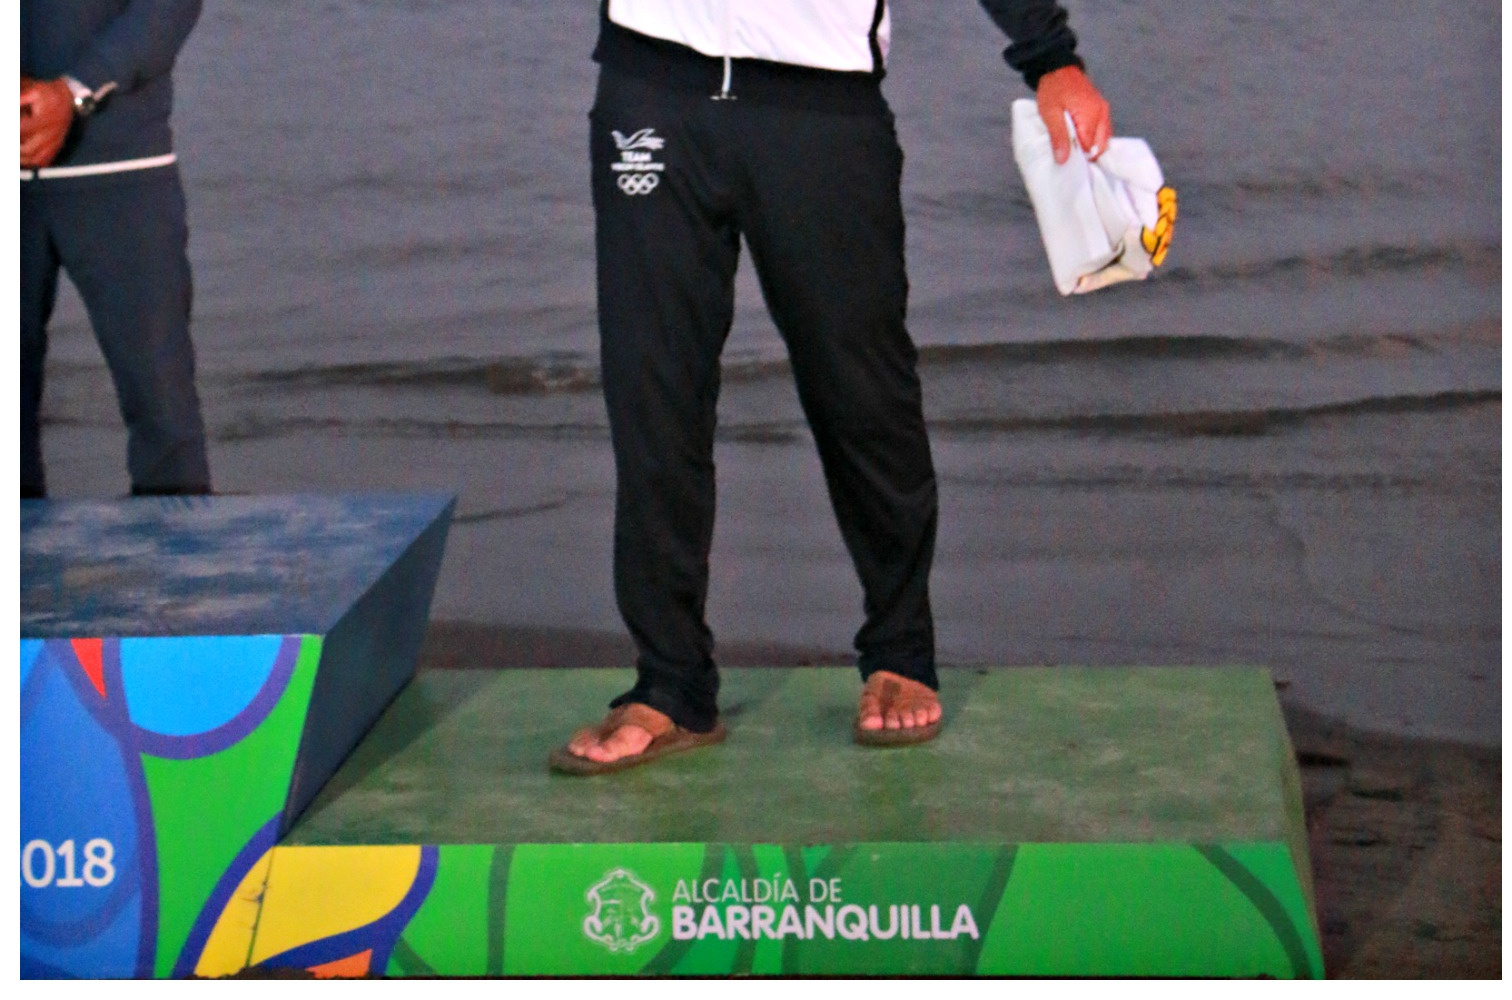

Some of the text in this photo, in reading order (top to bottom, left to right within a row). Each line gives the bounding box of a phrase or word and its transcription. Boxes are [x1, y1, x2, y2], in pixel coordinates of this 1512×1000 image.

[20, 838, 115, 888] 018
[672, 873, 842, 903] ALCALDÍA DE
[671, 904, 980, 942] BARRANQUILLA
